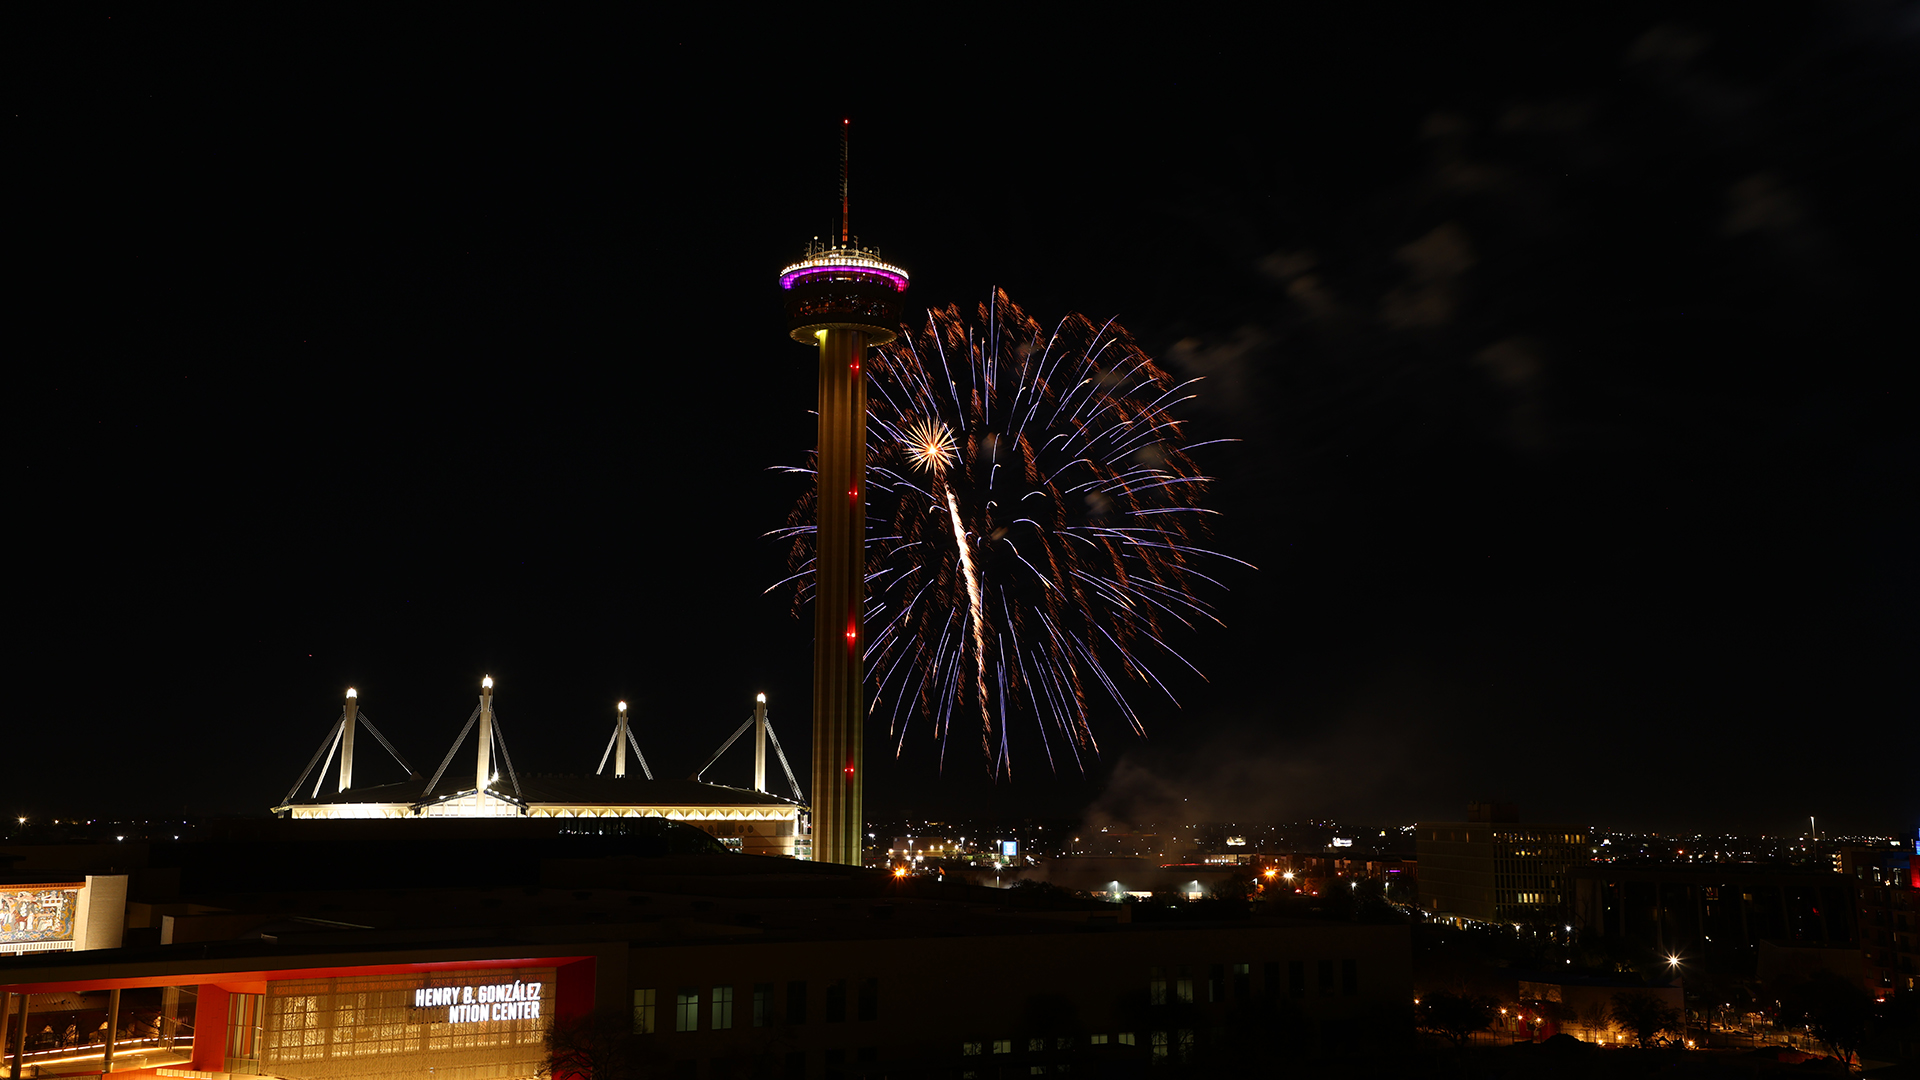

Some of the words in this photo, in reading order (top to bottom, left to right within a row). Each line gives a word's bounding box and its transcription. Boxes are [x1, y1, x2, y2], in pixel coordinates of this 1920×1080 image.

[415, 987, 461, 1007] HENRY
[463, 986, 476, 1004] B.
[478, 981, 541, 1003] GONZÁLEZ
[492, 1002, 540, 1021] CENTER
